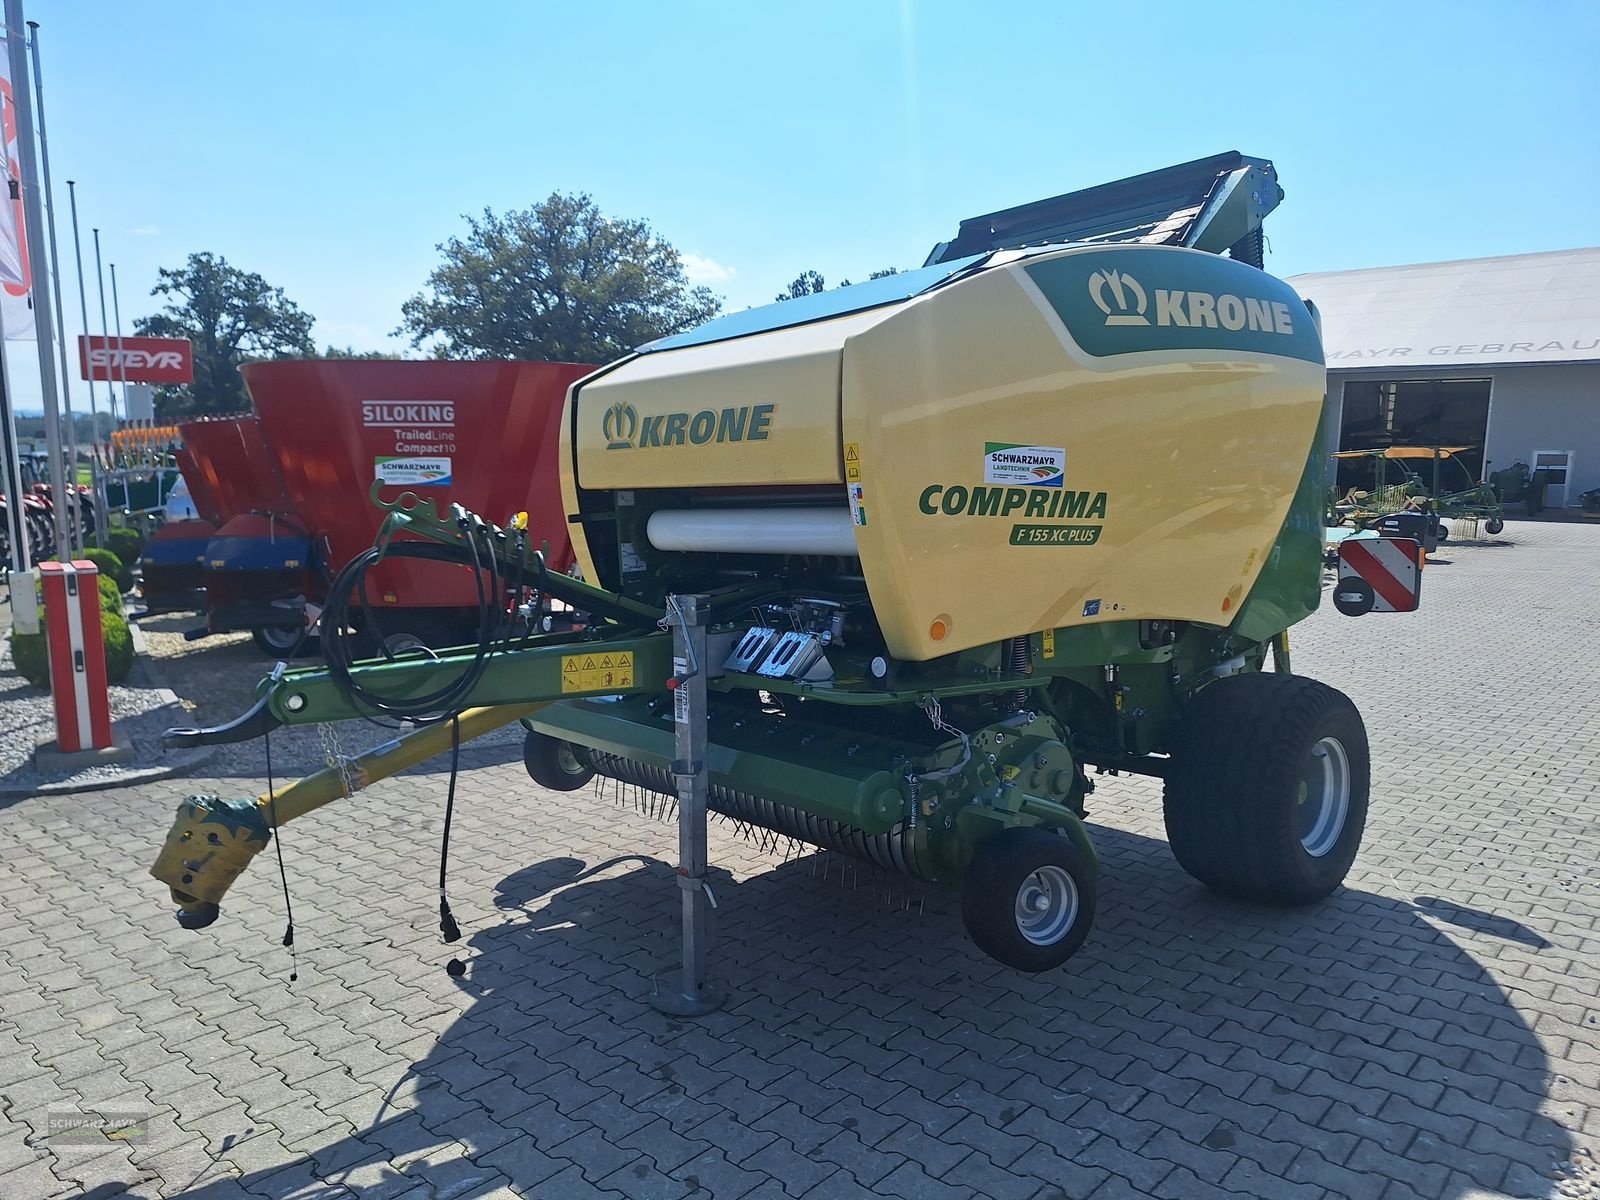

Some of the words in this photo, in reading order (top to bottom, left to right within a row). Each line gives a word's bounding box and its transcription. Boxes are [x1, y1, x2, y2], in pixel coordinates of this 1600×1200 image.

[1155, 289, 1293, 335] KRONE
[91, 348, 184, 369] STEYR
[362, 405, 455, 421] SILOKING
[638, 403, 776, 449] KRONE
[382, 463, 441, 471] SCHWARZMAYR
[992, 453, 1055, 466] SCHWARZMAYR
[993, 464, 1030, 473] LANDTECHNIK
[918, 484, 1108, 519] COMPRIMA
[1016, 529, 1026, 542] F
[1028, 529, 1050, 542] 155
[1050, 529, 1067, 542] XC
[1068, 529, 1095, 542] PLUS
